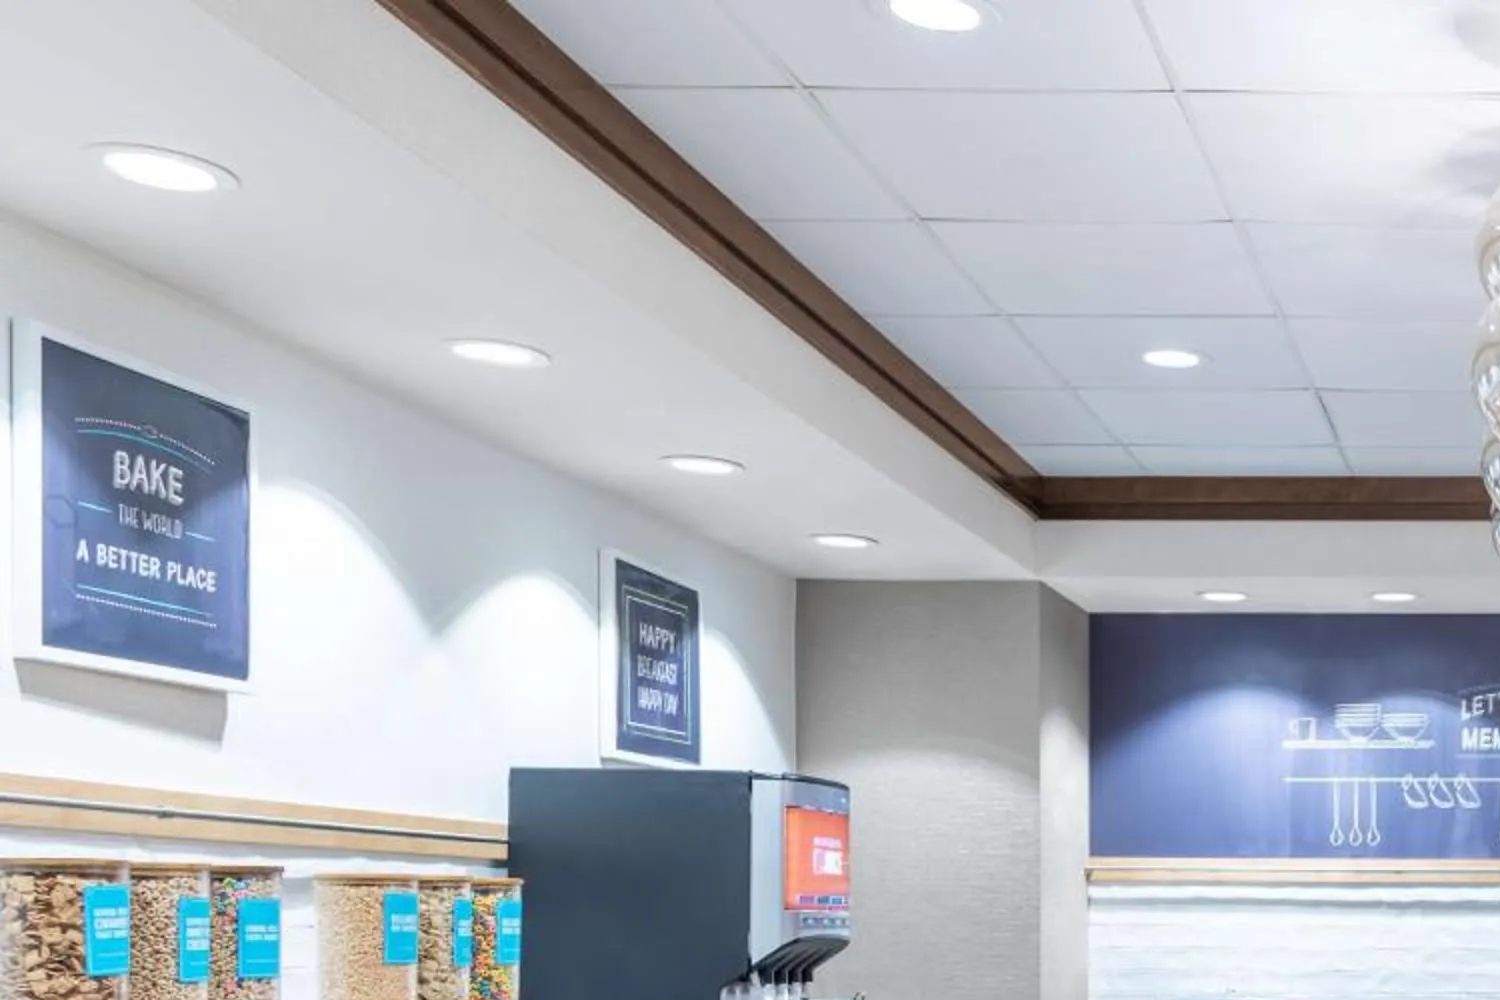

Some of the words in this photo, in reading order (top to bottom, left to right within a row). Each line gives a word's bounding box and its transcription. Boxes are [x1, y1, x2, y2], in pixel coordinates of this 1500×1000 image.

[113, 450, 185, 506] BAKE
[118, 503, 139, 529] THE
[141, 510, 184, 540] WORLD
[76, 538, 90, 564] A
[95, 543, 161, 581] BETTER
[167, 560, 218, 593] PLACE
[639, 621, 676, 655] HAPPY
